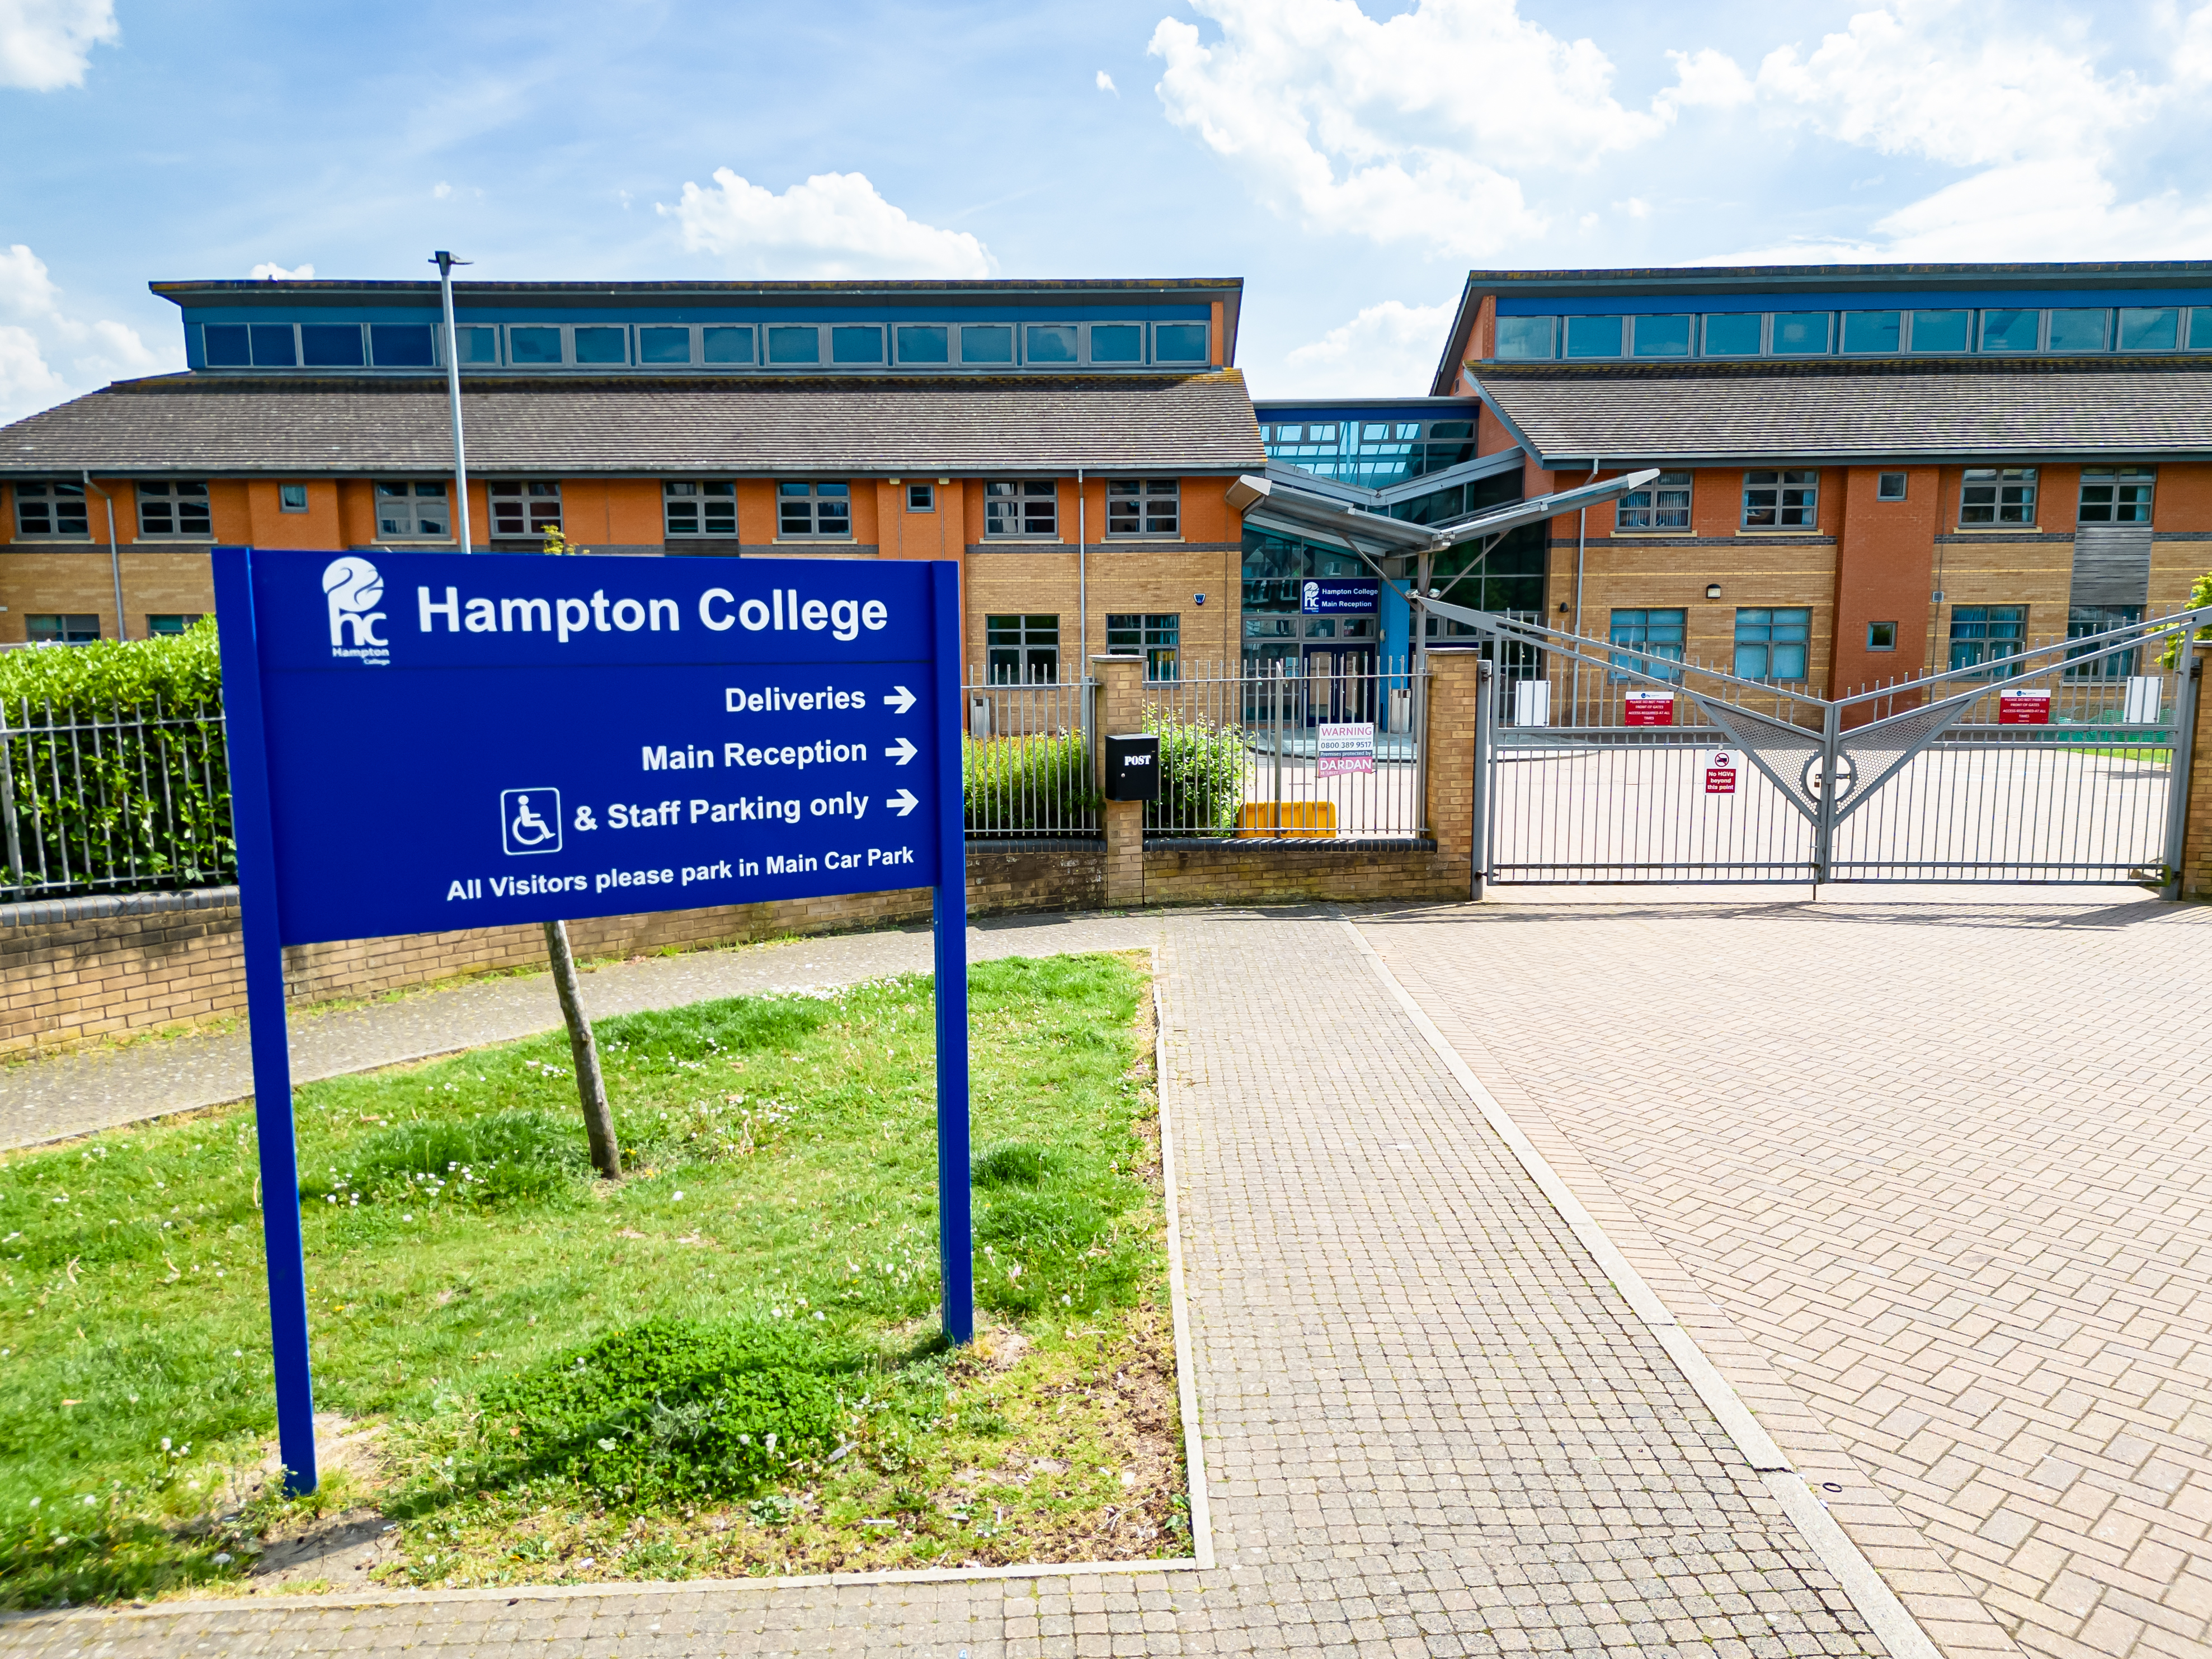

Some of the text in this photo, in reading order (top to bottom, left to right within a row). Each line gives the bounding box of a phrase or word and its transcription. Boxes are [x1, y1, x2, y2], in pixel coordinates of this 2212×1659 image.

[418, 586, 888, 643] Hampton College
[332, 647, 390, 659] Hampton
[726, 685, 867, 712] Deliveries
[1321, 727, 1372, 736] WARNING
[642, 739, 867, 771] Main Reception
[1124, 755, 1151, 766] POST
[1320, 759, 1372, 770] DARDAN
[574, 790, 869, 831] & Staff Parking only
[447, 846, 915, 901] All Visitors please park in Main Car Park
